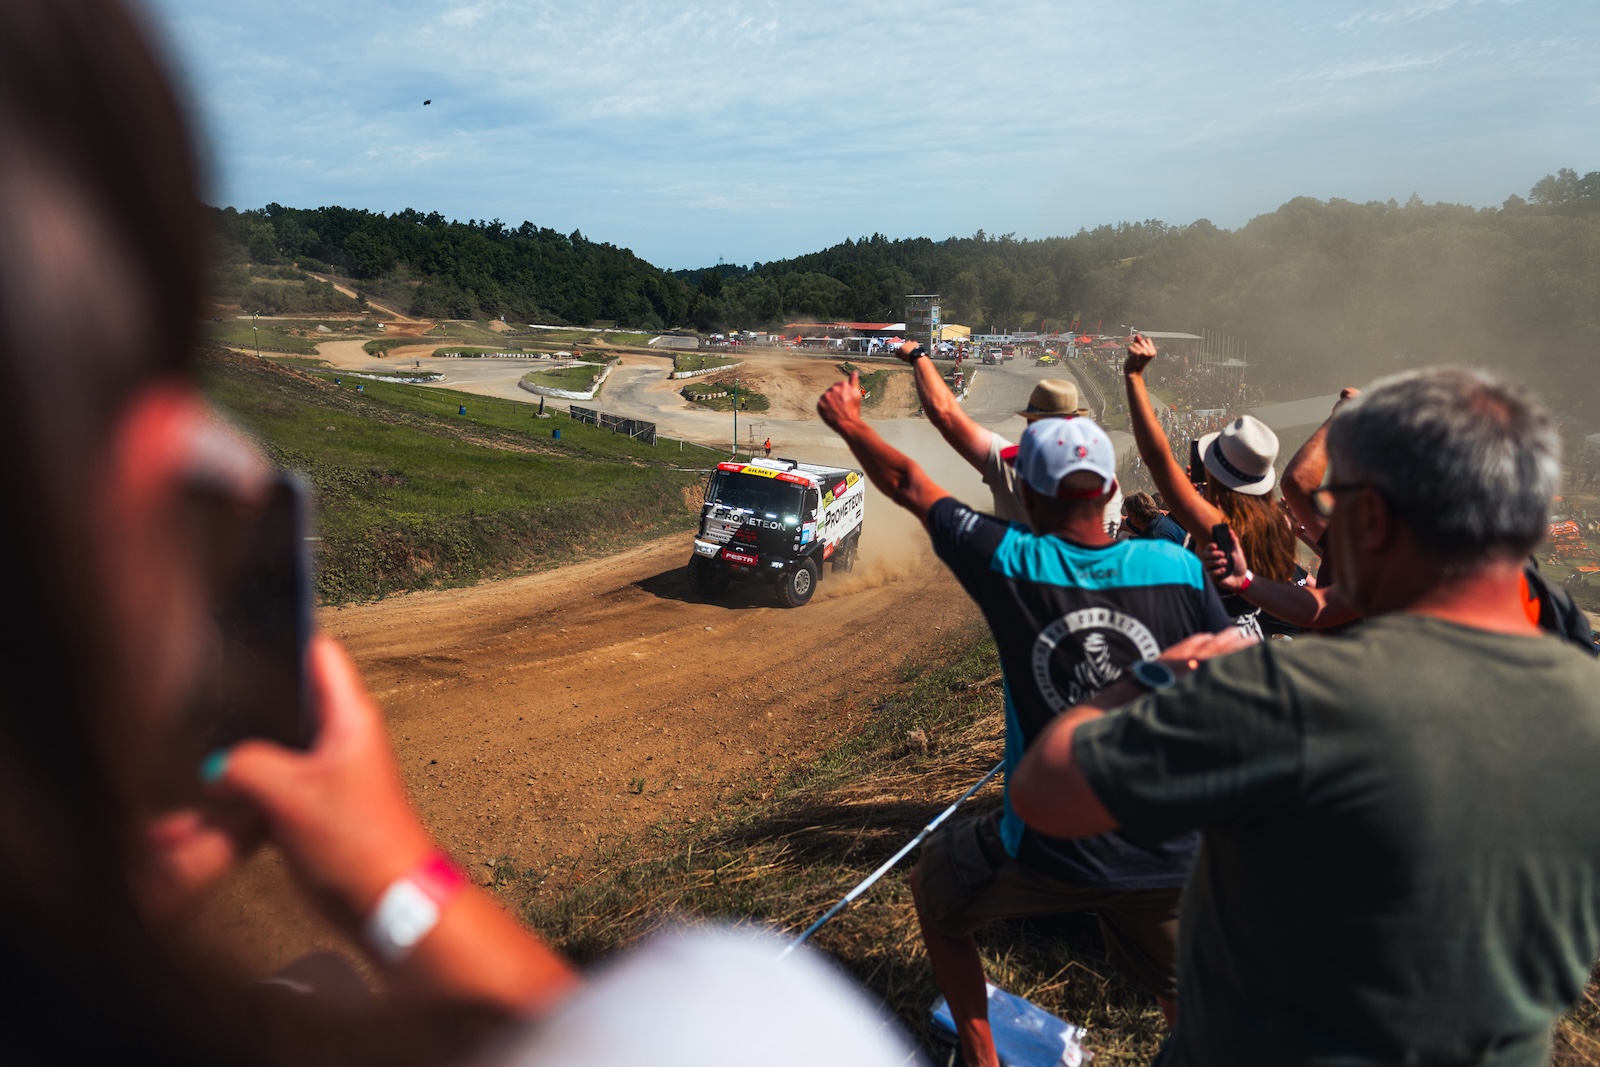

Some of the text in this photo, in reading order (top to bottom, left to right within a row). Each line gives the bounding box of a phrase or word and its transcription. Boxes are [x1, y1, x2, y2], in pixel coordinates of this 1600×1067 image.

[747, 467, 773, 476] SILMET
[713, 508, 786, 532] PROMETEON
[824, 491, 863, 534] PROMETEON
[726, 552, 754, 563] FESTA
